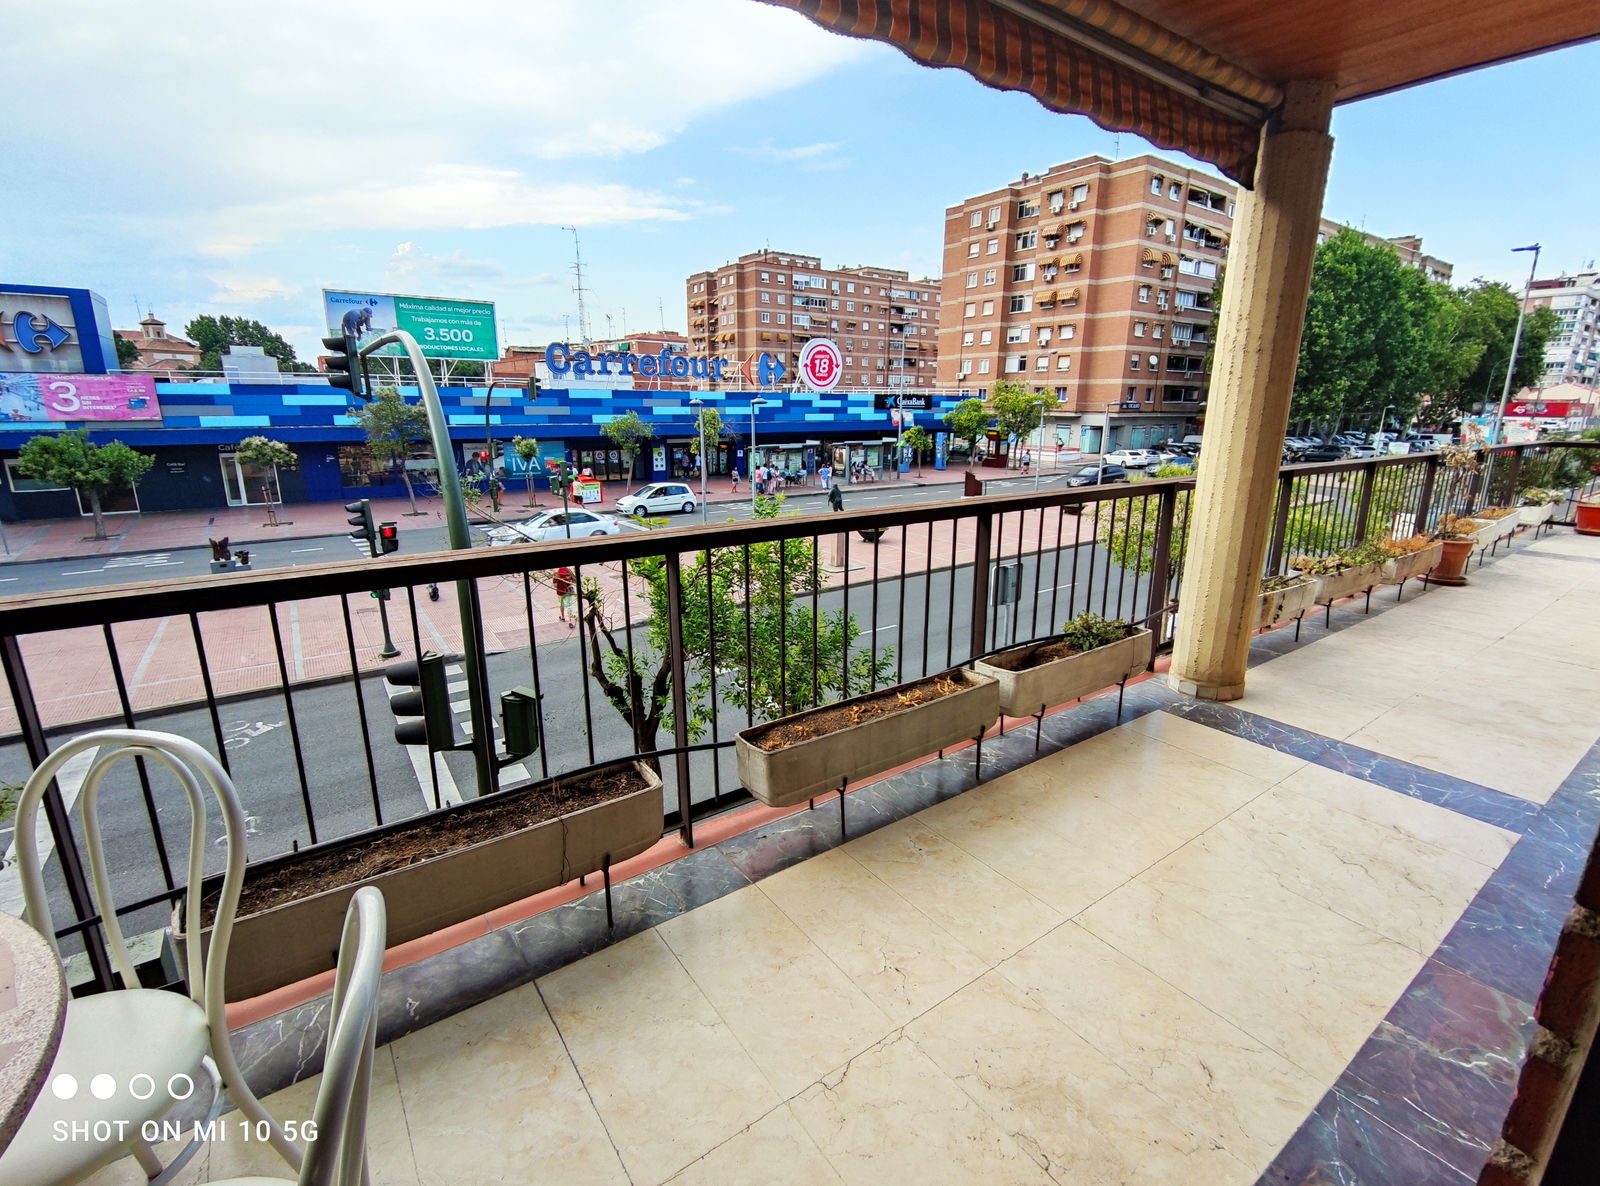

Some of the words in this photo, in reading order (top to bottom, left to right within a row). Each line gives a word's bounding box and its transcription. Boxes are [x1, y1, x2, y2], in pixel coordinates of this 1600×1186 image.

[331, 297, 362, 305] Carrefour
[411, 315, 448, 324] Trabajamos
[460, 318, 473, 326] más
[423, 327, 473, 343] 3.500
[545, 342, 728, 379] Carrefour
[814, 358, 830, 374] 18
[49, 381, 80, 412] 3
[896, 397, 926, 406] CaixaBank
[511, 456, 541, 471] IVA
